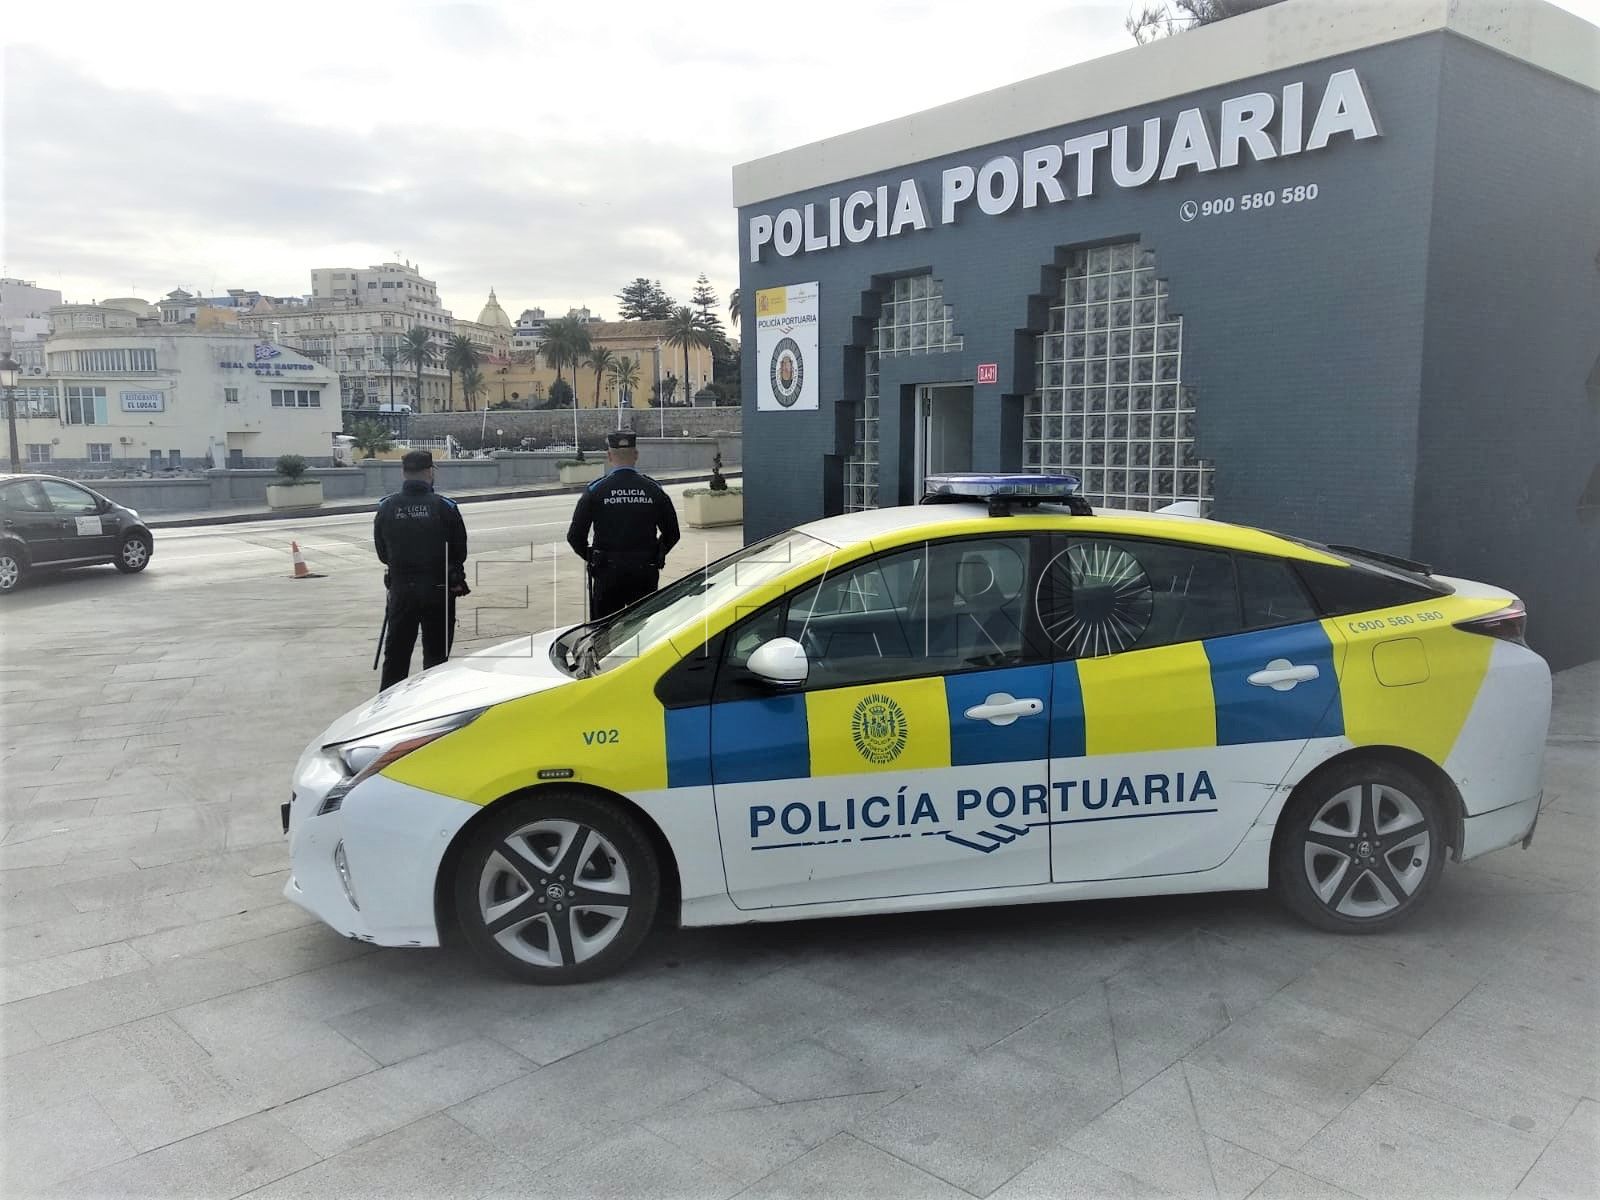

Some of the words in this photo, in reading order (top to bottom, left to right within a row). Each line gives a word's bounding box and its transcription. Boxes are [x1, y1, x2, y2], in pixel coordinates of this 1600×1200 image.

[750, 178, 928, 263] POLICIA
[942, 68, 1378, 224] PORTUARIA
[1201, 197, 1235, 216] 900
[1241, 190, 1275, 210] 580
[1281, 183, 1318, 204] 580
[782, 314, 817, 325] PORTUARIA
[604, 496, 653, 504] PORTUARIA
[1358, 619, 1385, 631] 900
[1387, 615, 1414, 626] 580
[1417, 610, 1444, 622] 580
[582, 729, 620, 745] V02
[750, 785, 940, 838] POLICÍA
[956, 770, 1218, 821] PORTUARIA
